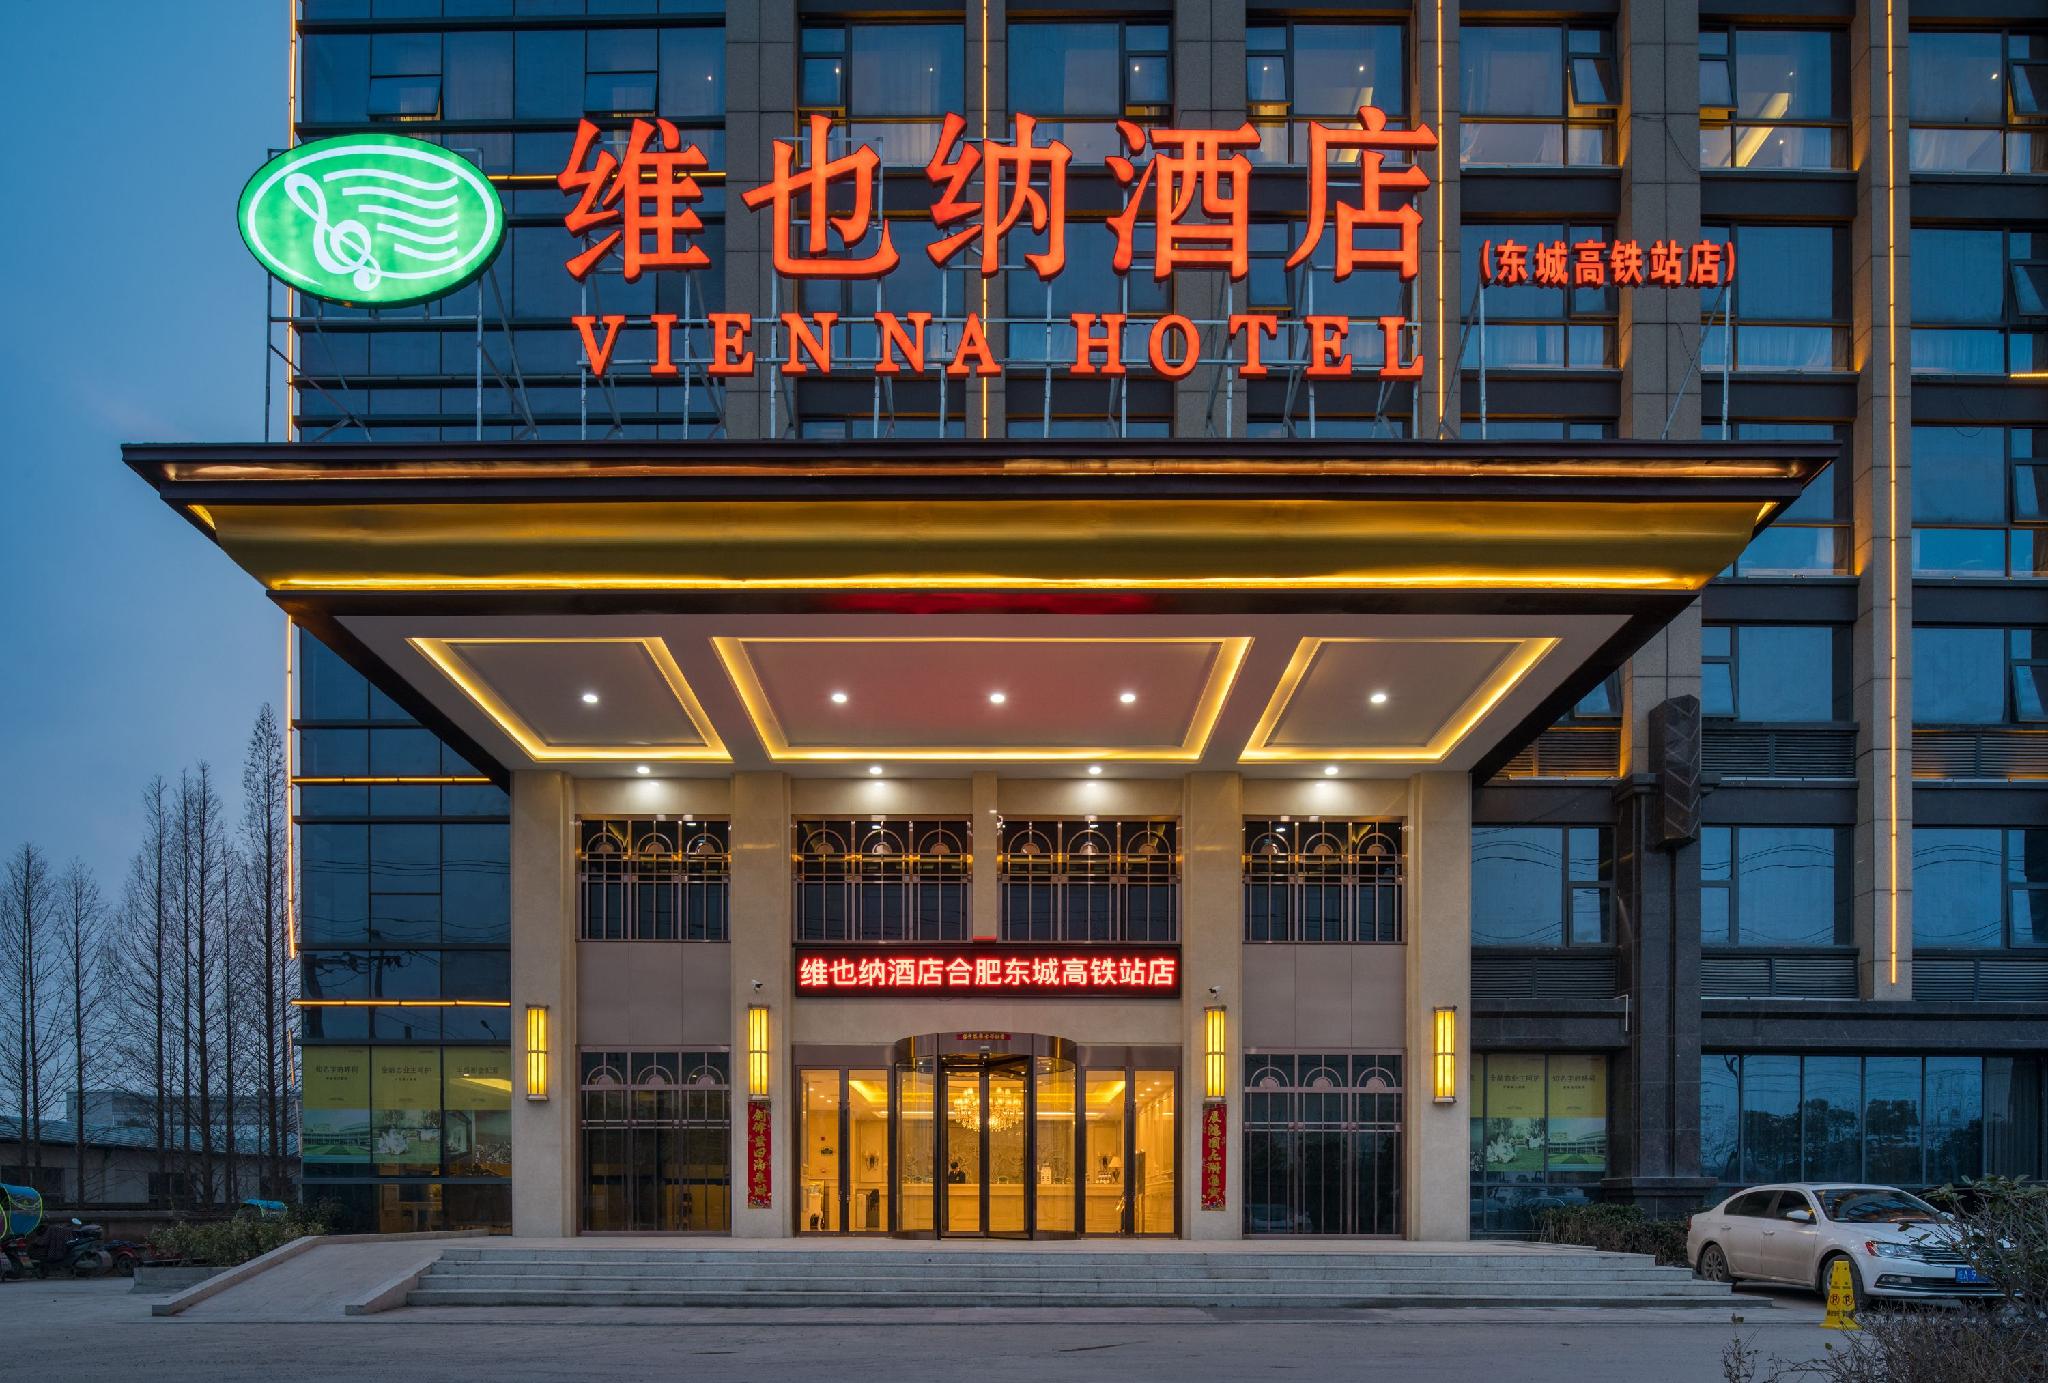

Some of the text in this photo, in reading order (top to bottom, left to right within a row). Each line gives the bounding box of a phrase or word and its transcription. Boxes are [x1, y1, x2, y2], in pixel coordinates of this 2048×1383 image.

[557, 106, 1440, 281] 维也纳酒店
[1480, 240, 1736, 287] (东城高铁站店)
[572, 312, 1425, 381] VIENNA HOTEL
[799, 957, 1176, 988] 维也纳酒店合肥东城高铁站店
